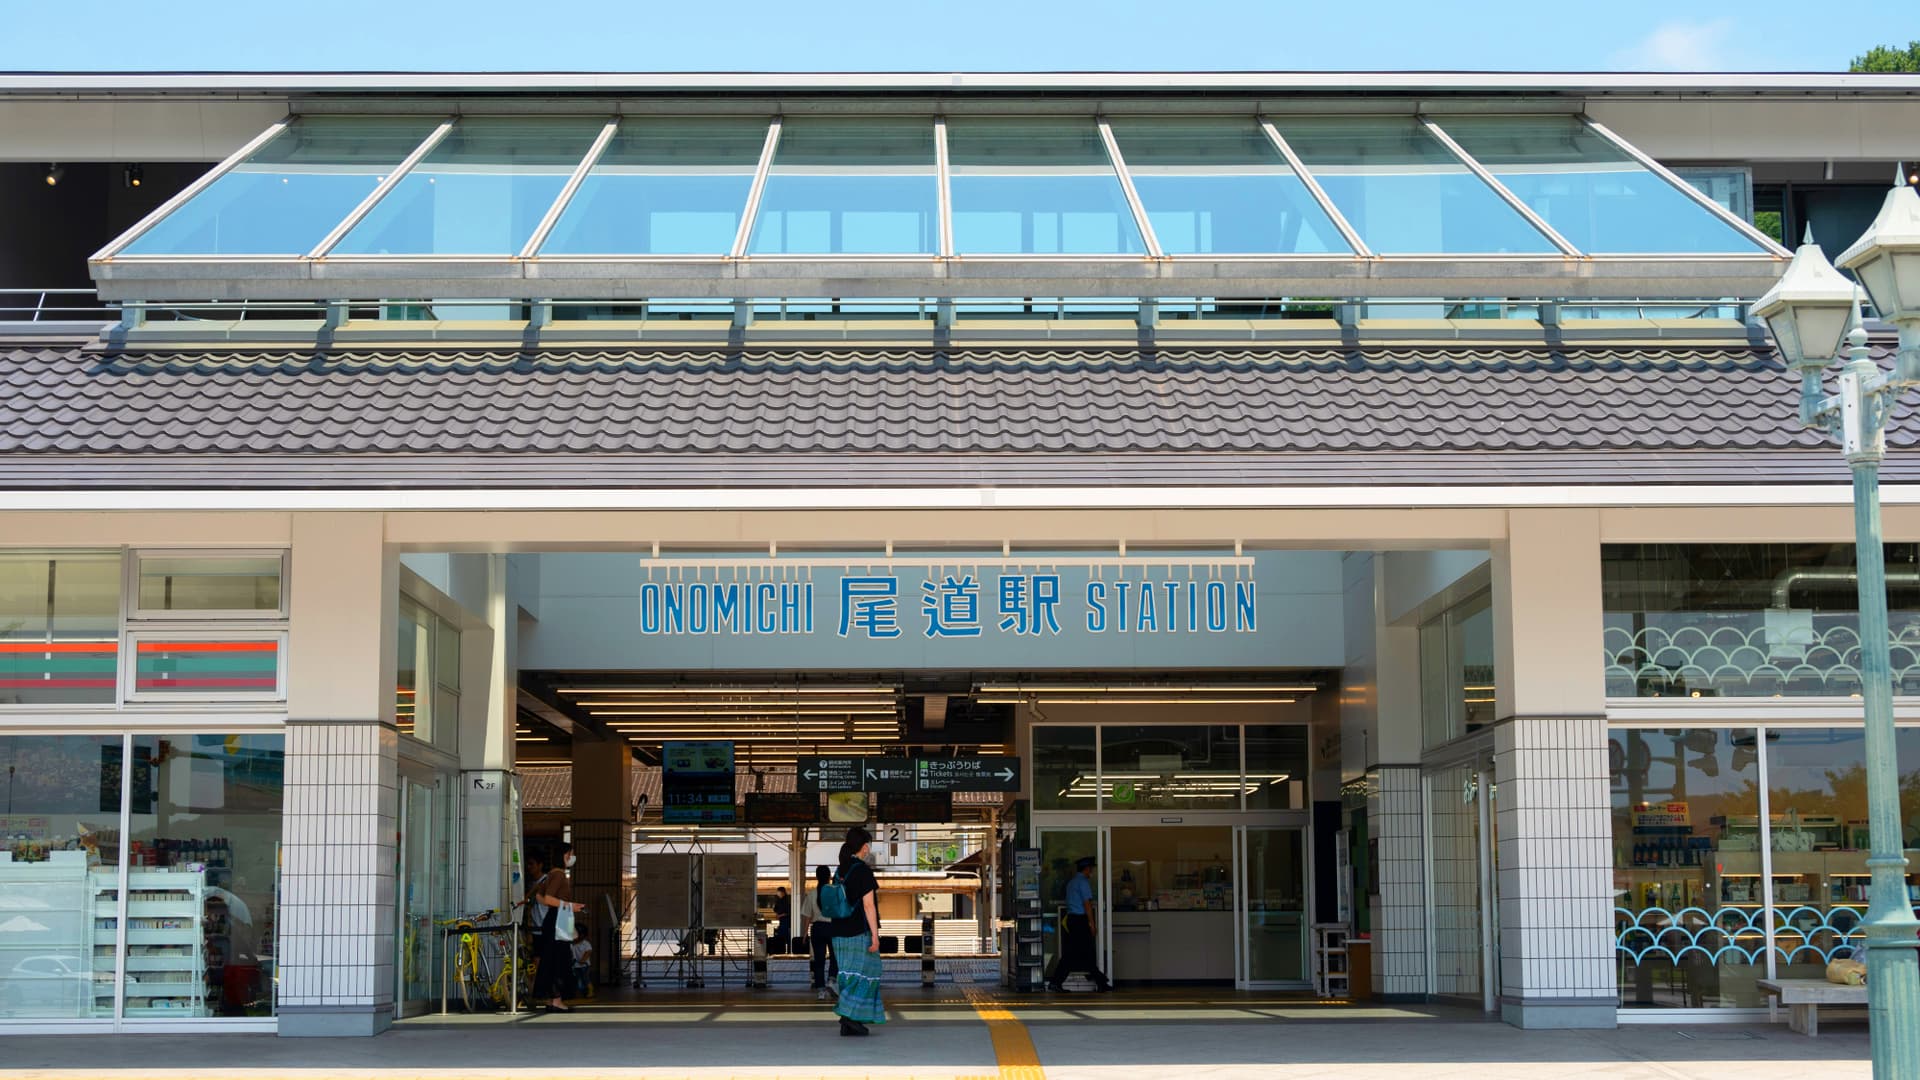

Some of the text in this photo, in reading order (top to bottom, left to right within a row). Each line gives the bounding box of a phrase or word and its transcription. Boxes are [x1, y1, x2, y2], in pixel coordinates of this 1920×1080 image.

[641, 575, 1256, 637] ONOMICHI 尾道駅 STATION
[928, 760, 982, 770] きっぷうりば
[928, 770, 953, 778] Tickets
[669, 793, 703, 804] 11:34
[889, 828, 900, 841] 2
